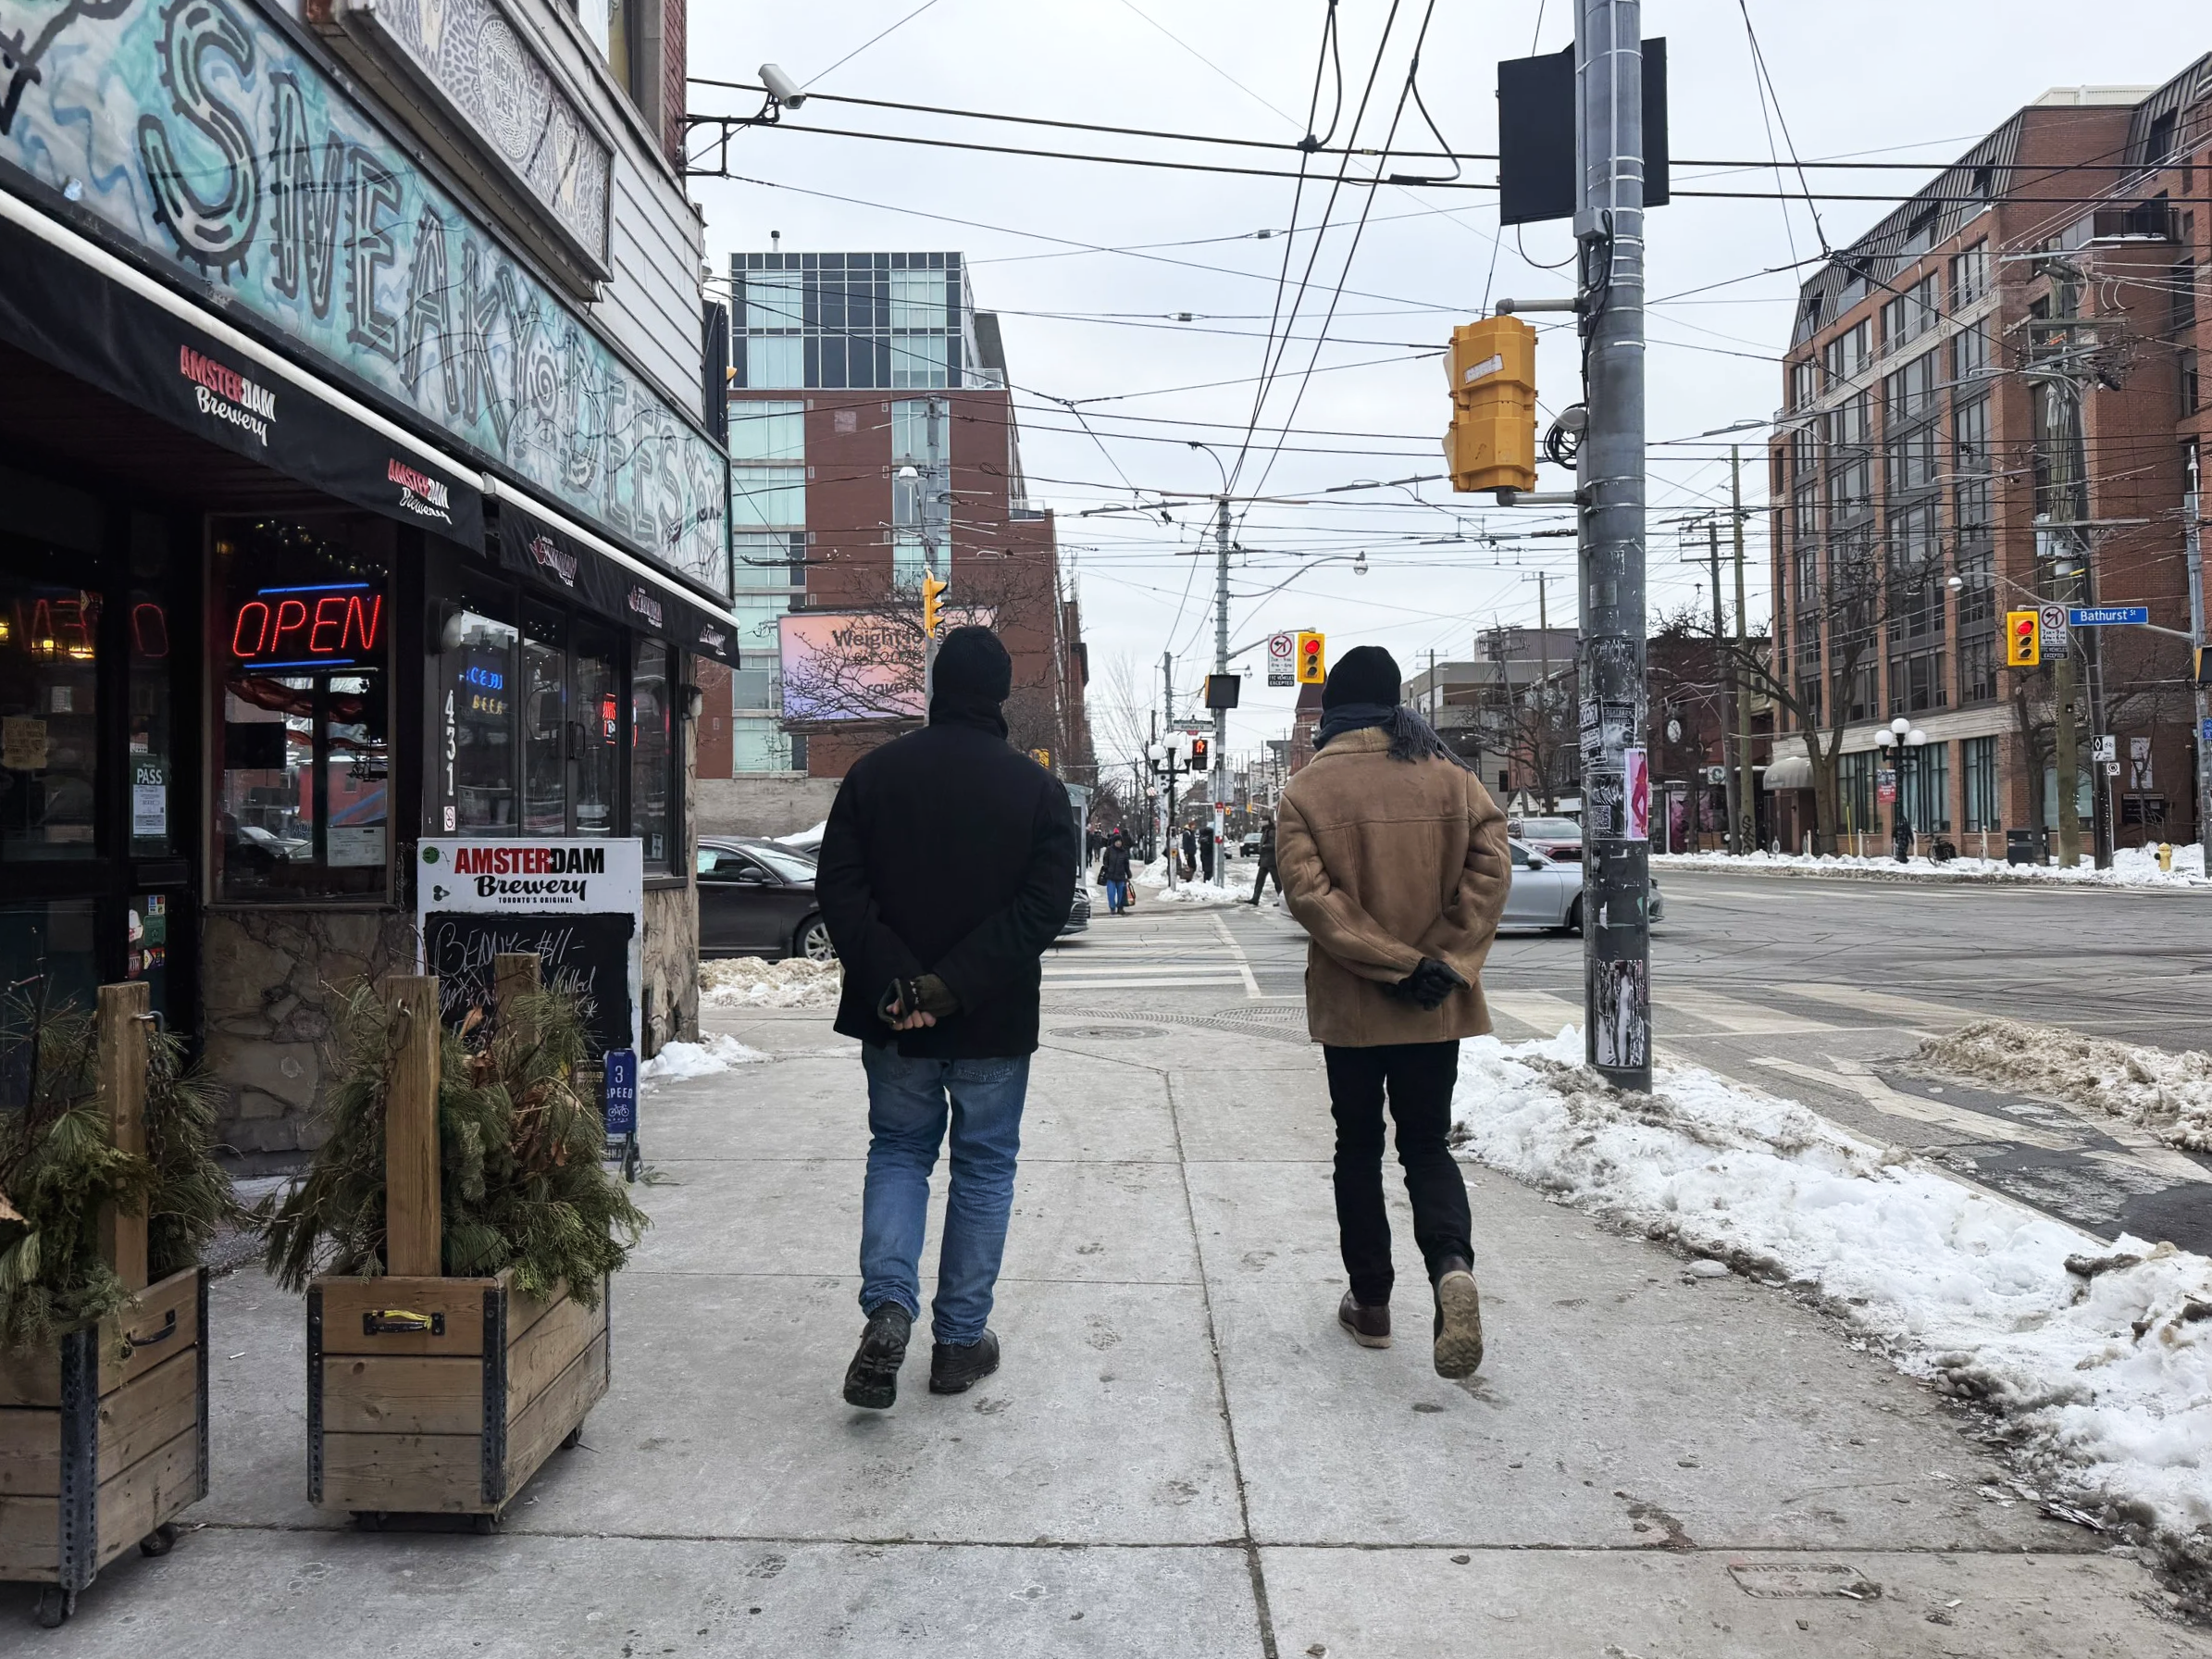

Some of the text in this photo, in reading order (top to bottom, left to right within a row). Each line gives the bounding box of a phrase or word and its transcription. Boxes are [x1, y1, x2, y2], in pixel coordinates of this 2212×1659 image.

[138, 0, 540, 458] SNEAKY
[180, 344, 276, 422] AMSTERDAM
[194, 385, 268, 447] Brewery
[388, 457, 451, 509] AMSTERDAM
[399, 487, 453, 525] Brewery
[233, 594, 381, 657] OPEN
[2080, 609, 2128, 622] Bathurst
[833, 629, 901, 652] Weight
[444, 689, 456, 796] 431
[136, 767, 163, 785] PASS
[454, 847, 604, 874] AMSTERDAM
[474, 875, 588, 902] Brewery
[615, 1065, 624, 1084] 3
